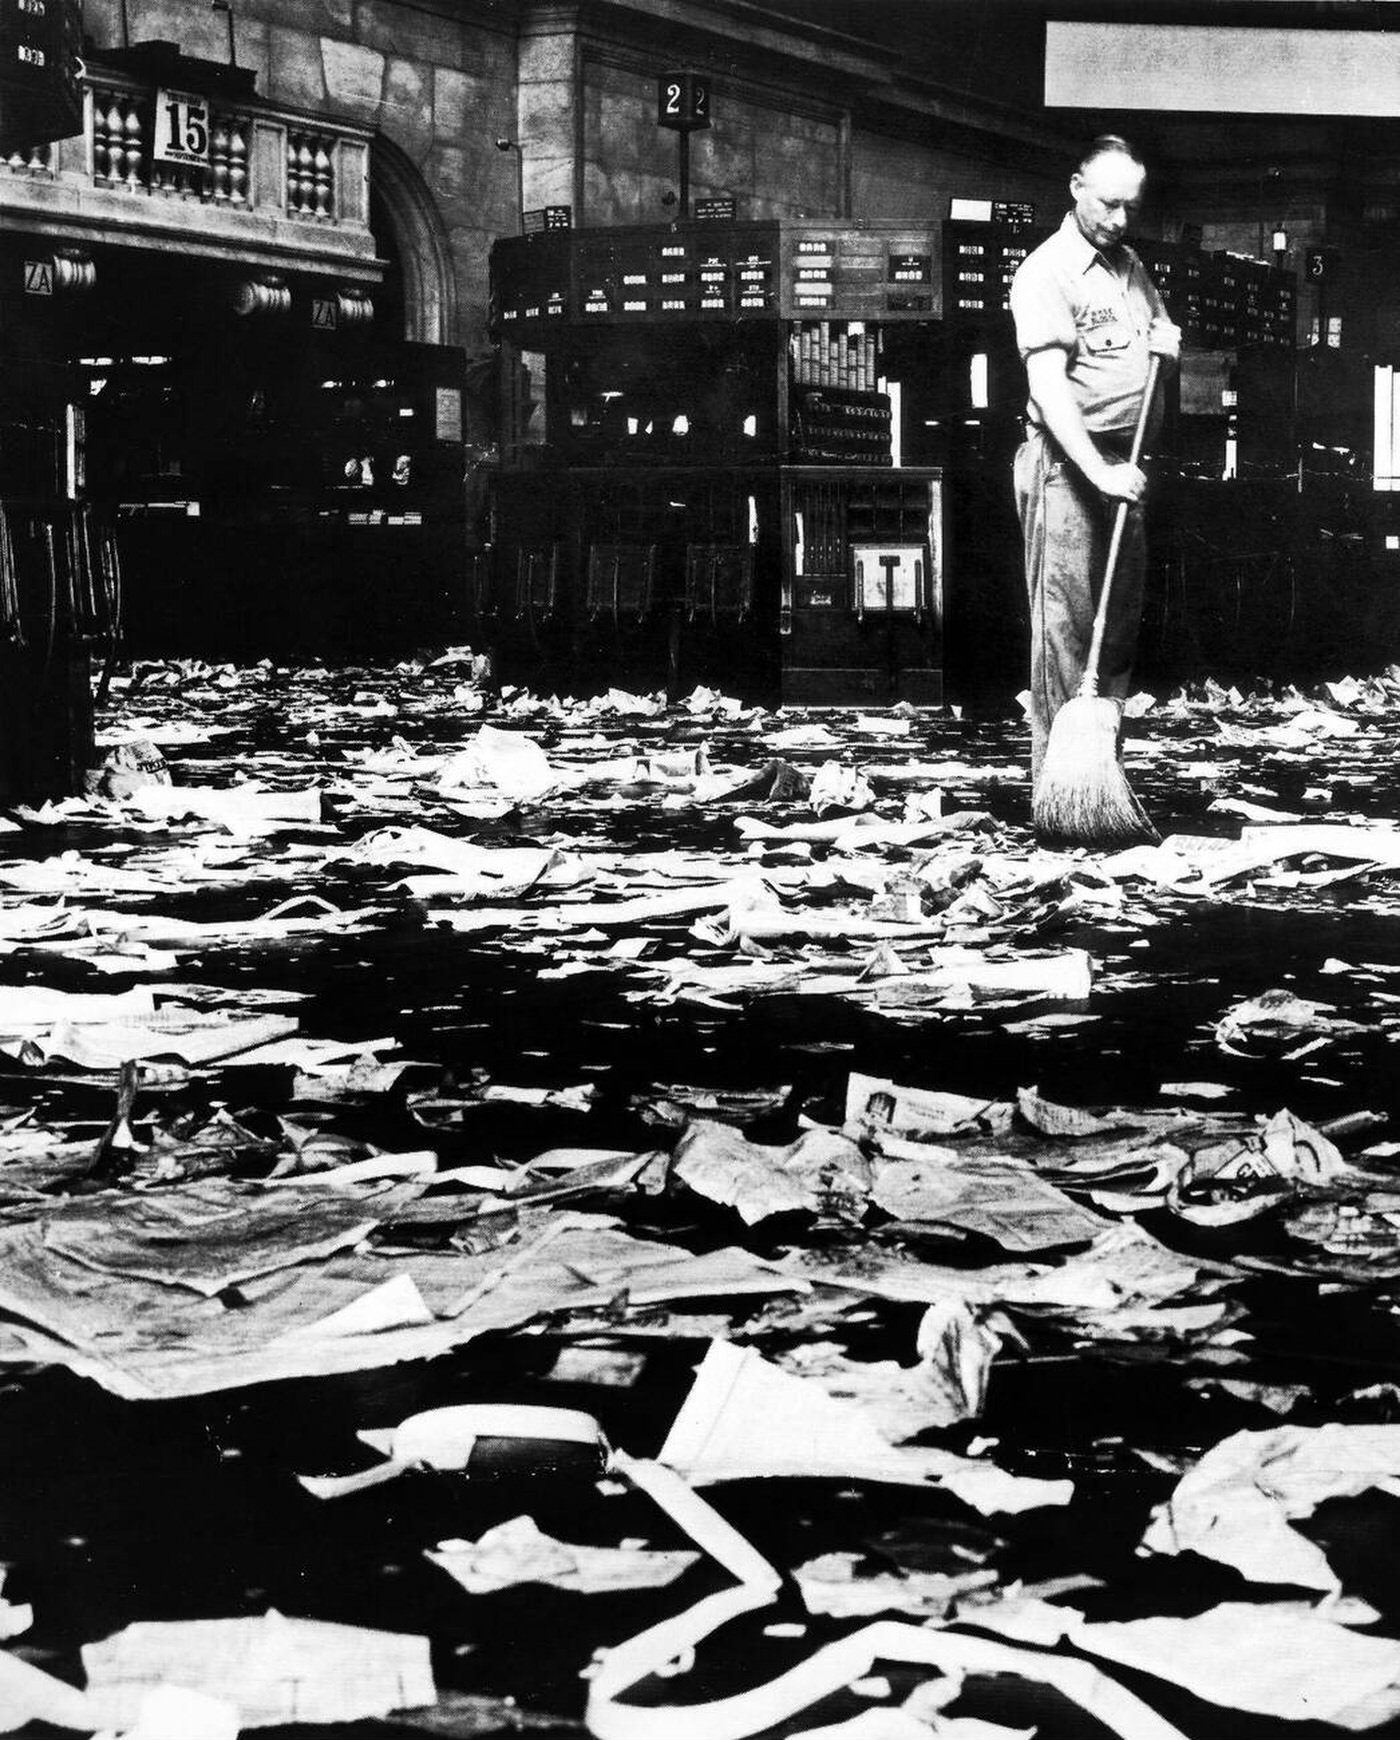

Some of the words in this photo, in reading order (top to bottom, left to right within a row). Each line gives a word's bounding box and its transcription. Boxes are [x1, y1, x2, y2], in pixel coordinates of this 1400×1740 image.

[666, 83, 681, 114] 2
[696, 87, 706, 116] 2
[165, 103, 207, 155] 15
[1312, 255, 1324, 276] 3
